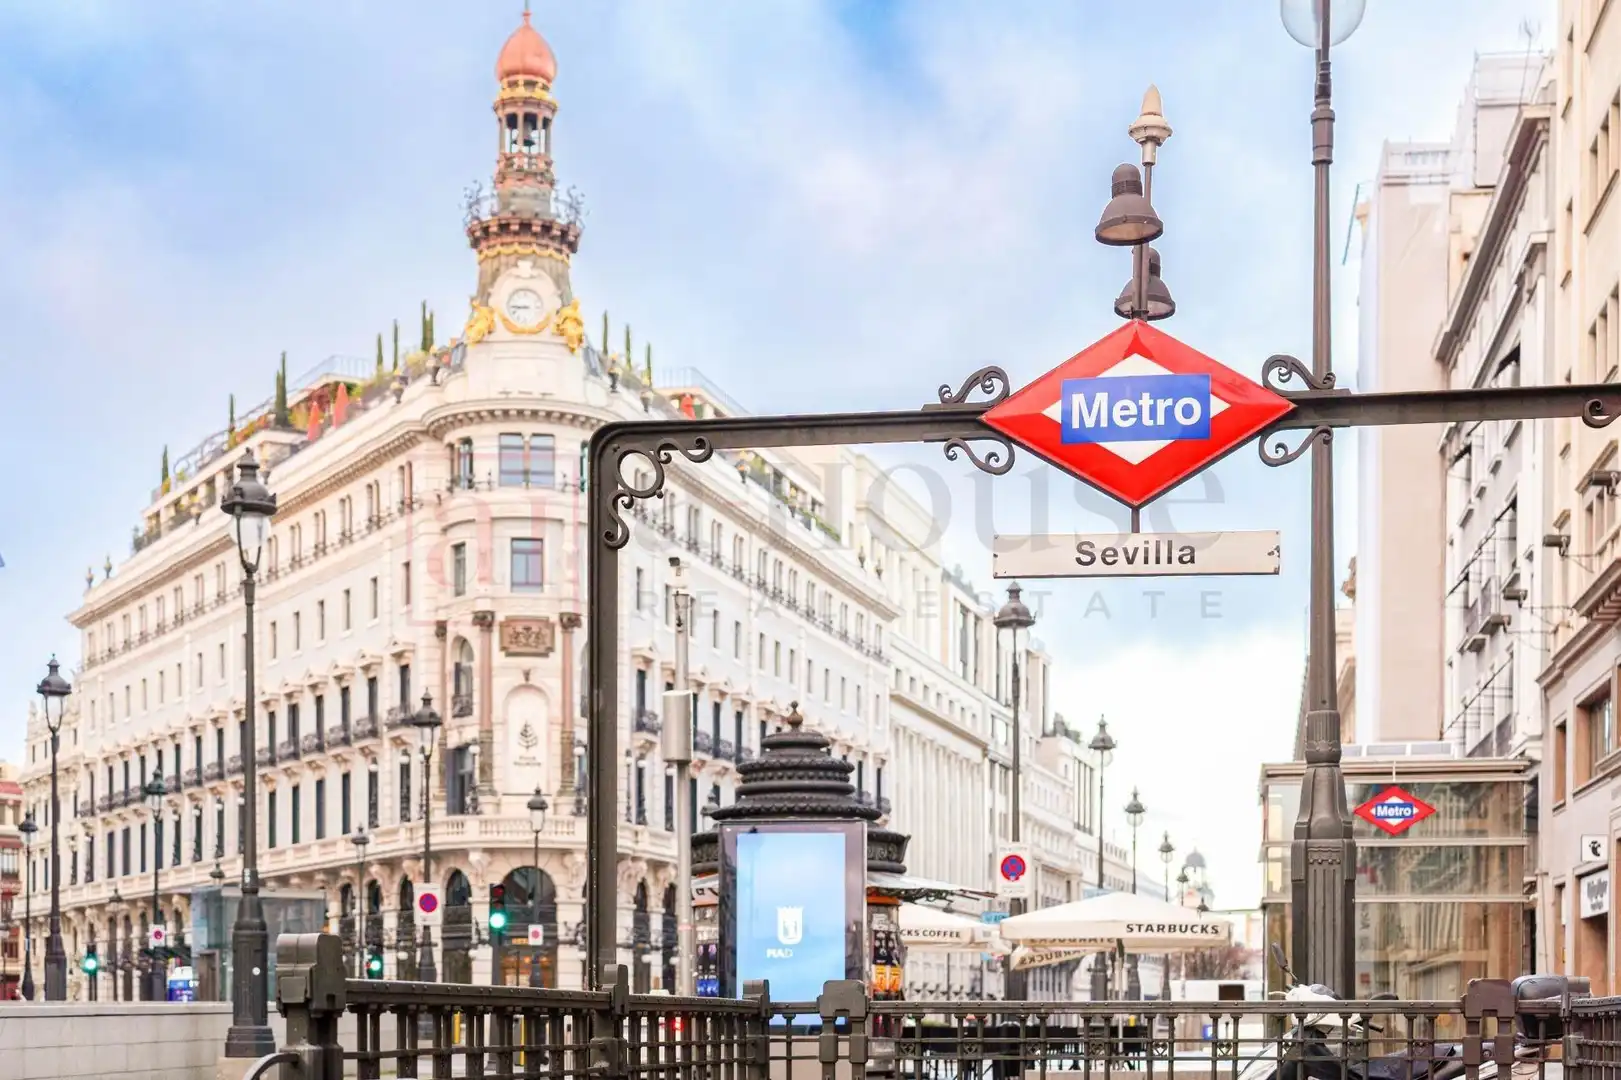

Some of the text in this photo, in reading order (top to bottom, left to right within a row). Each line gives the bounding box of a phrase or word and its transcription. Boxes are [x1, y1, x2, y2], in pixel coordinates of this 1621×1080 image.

[1071, 391, 1202, 429] Metro
[1075, 539, 1196, 567] Sevilla
[1376, 805, 1412, 817] Metro
[922, 929, 961, 938] COFFEE
[1126, 923, 1220, 935] STARBUCKS
